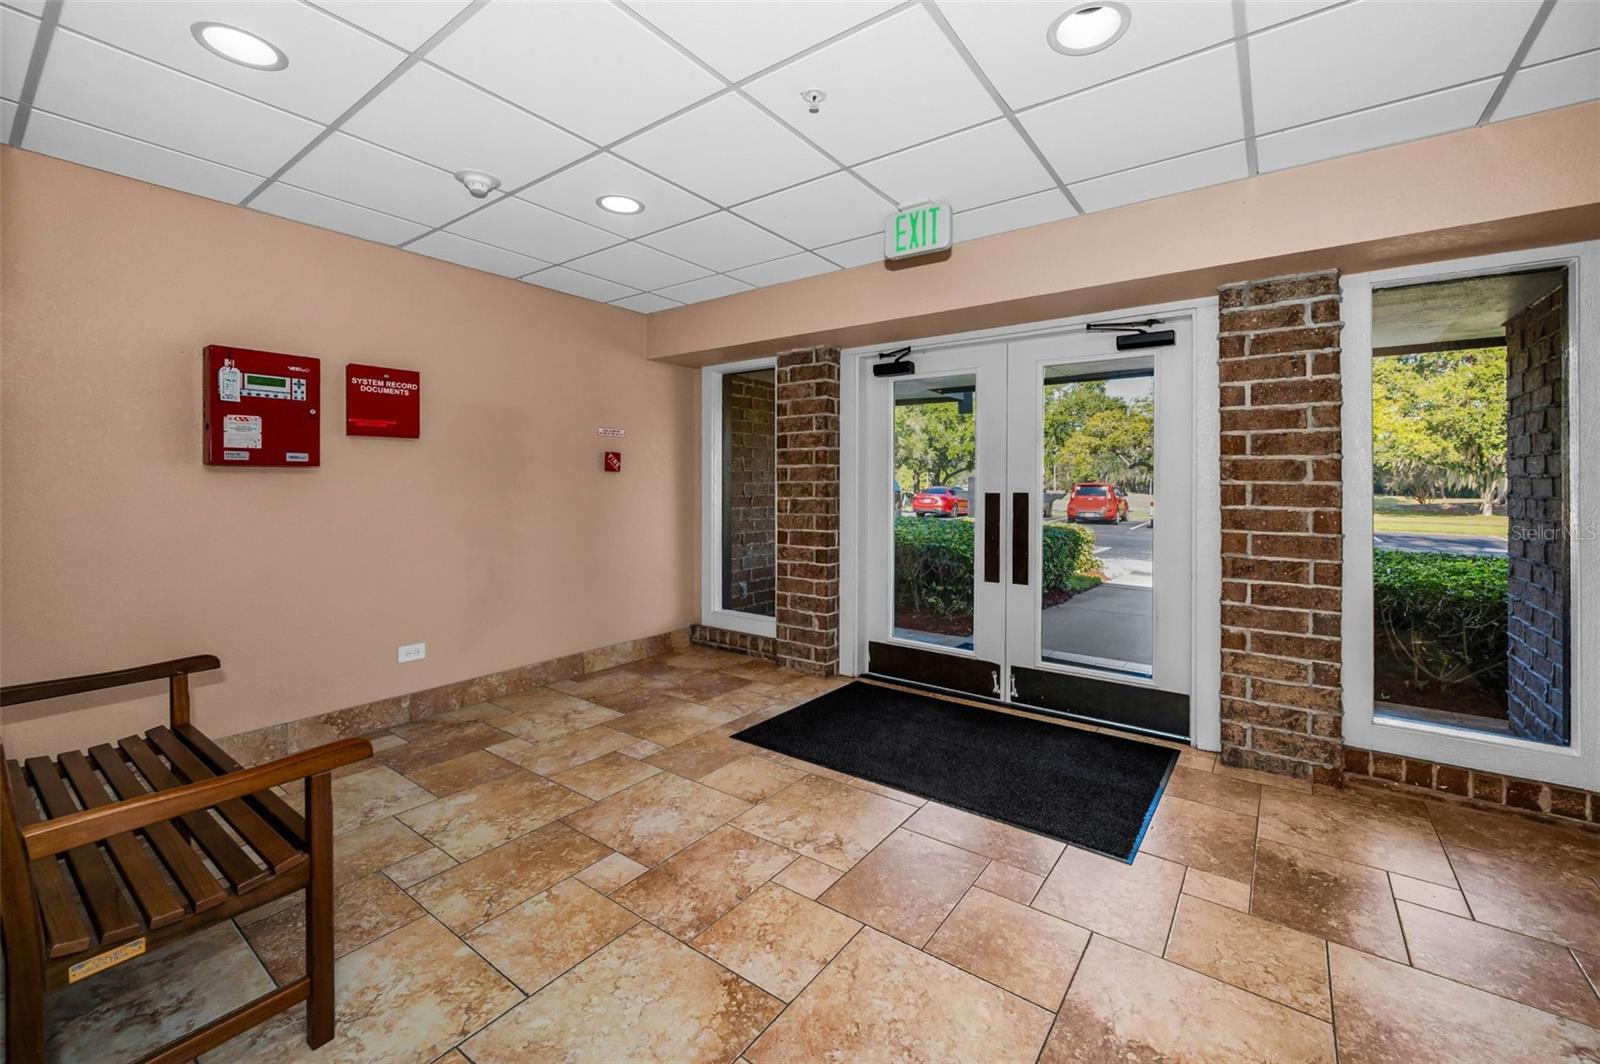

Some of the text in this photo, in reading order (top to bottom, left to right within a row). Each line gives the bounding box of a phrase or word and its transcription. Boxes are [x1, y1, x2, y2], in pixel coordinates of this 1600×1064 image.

[896, 207, 940, 252] EXIT
[351, 377, 418, 391] SYSTEM RECORD
[360, 385, 409, 396] DOCUMENTS
